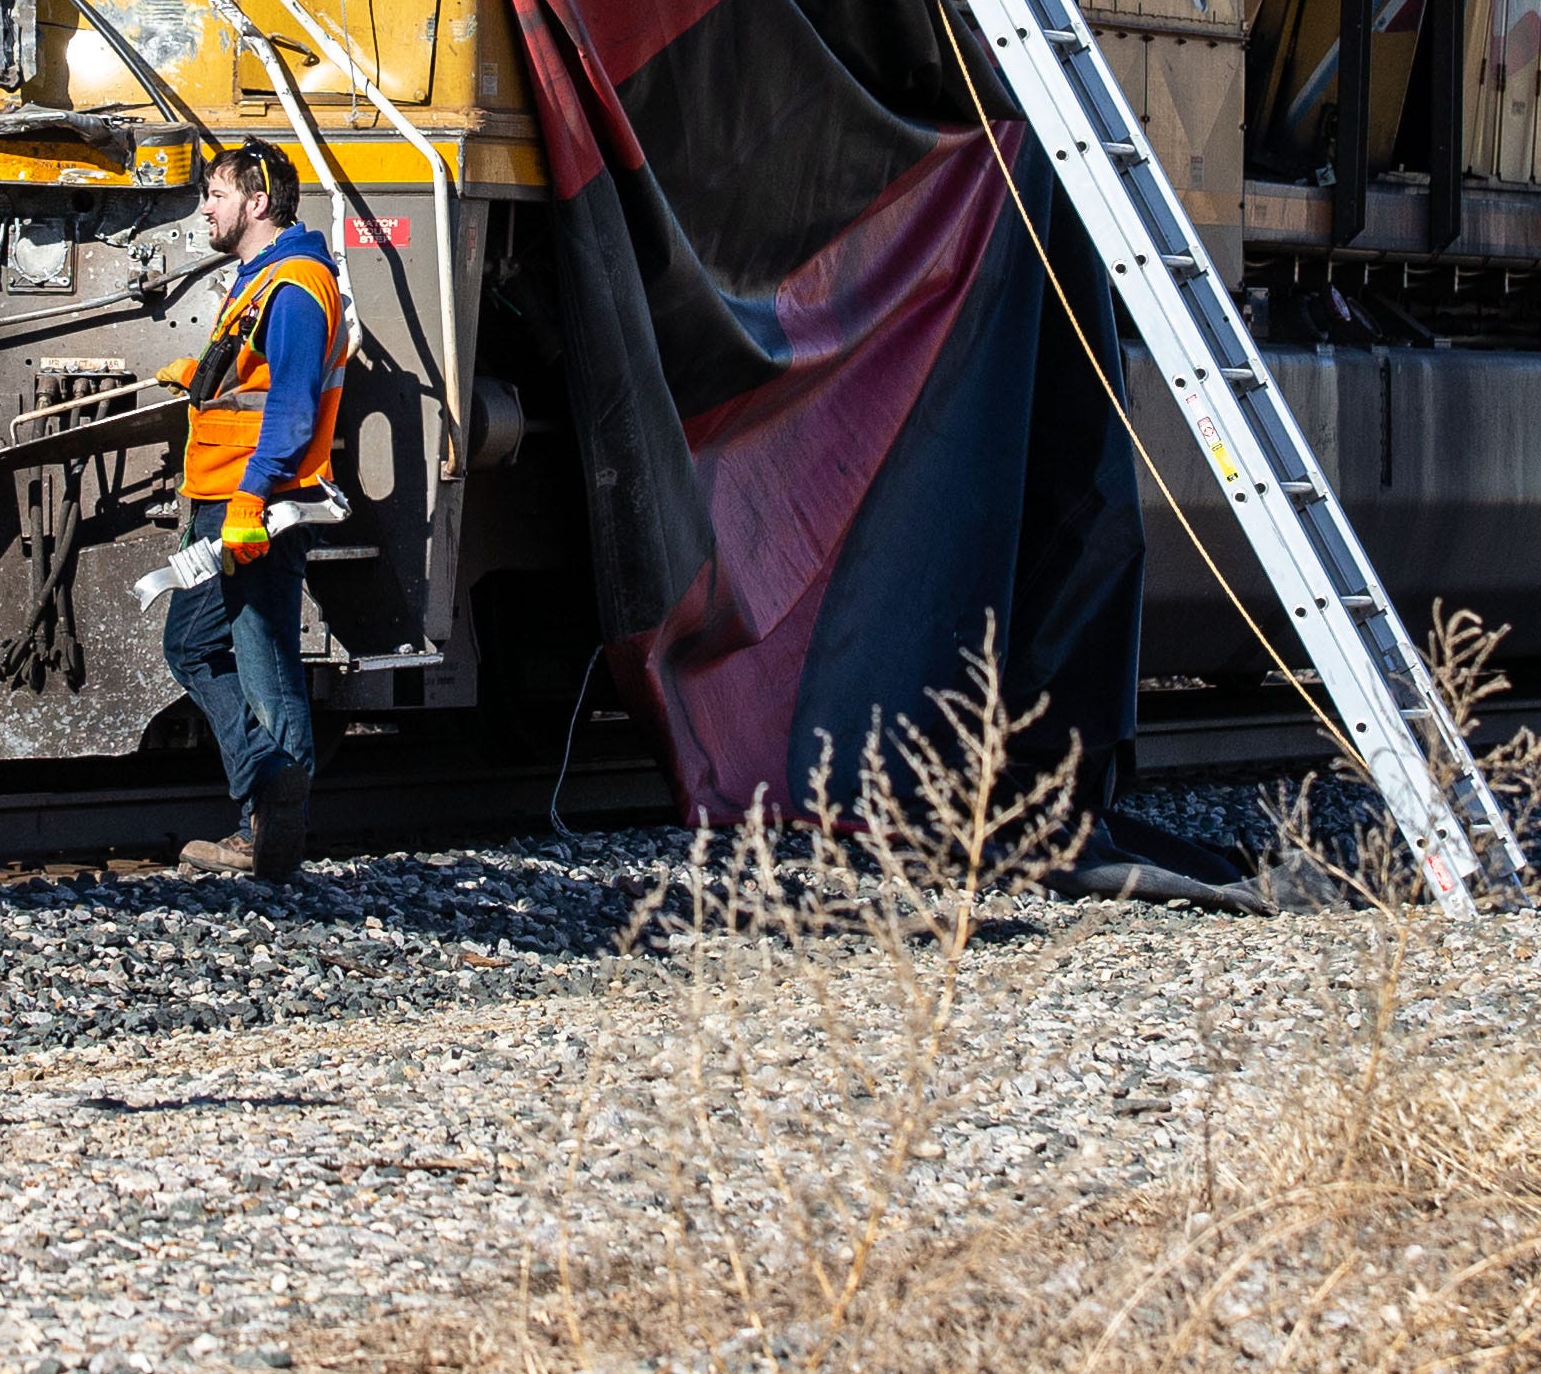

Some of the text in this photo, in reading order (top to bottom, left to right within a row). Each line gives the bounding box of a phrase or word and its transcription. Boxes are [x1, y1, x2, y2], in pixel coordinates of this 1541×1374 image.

[352, 218, 399, 228] WATCH
[355, 227, 392, 236] YOUR
[358, 235, 392, 244] STEP
